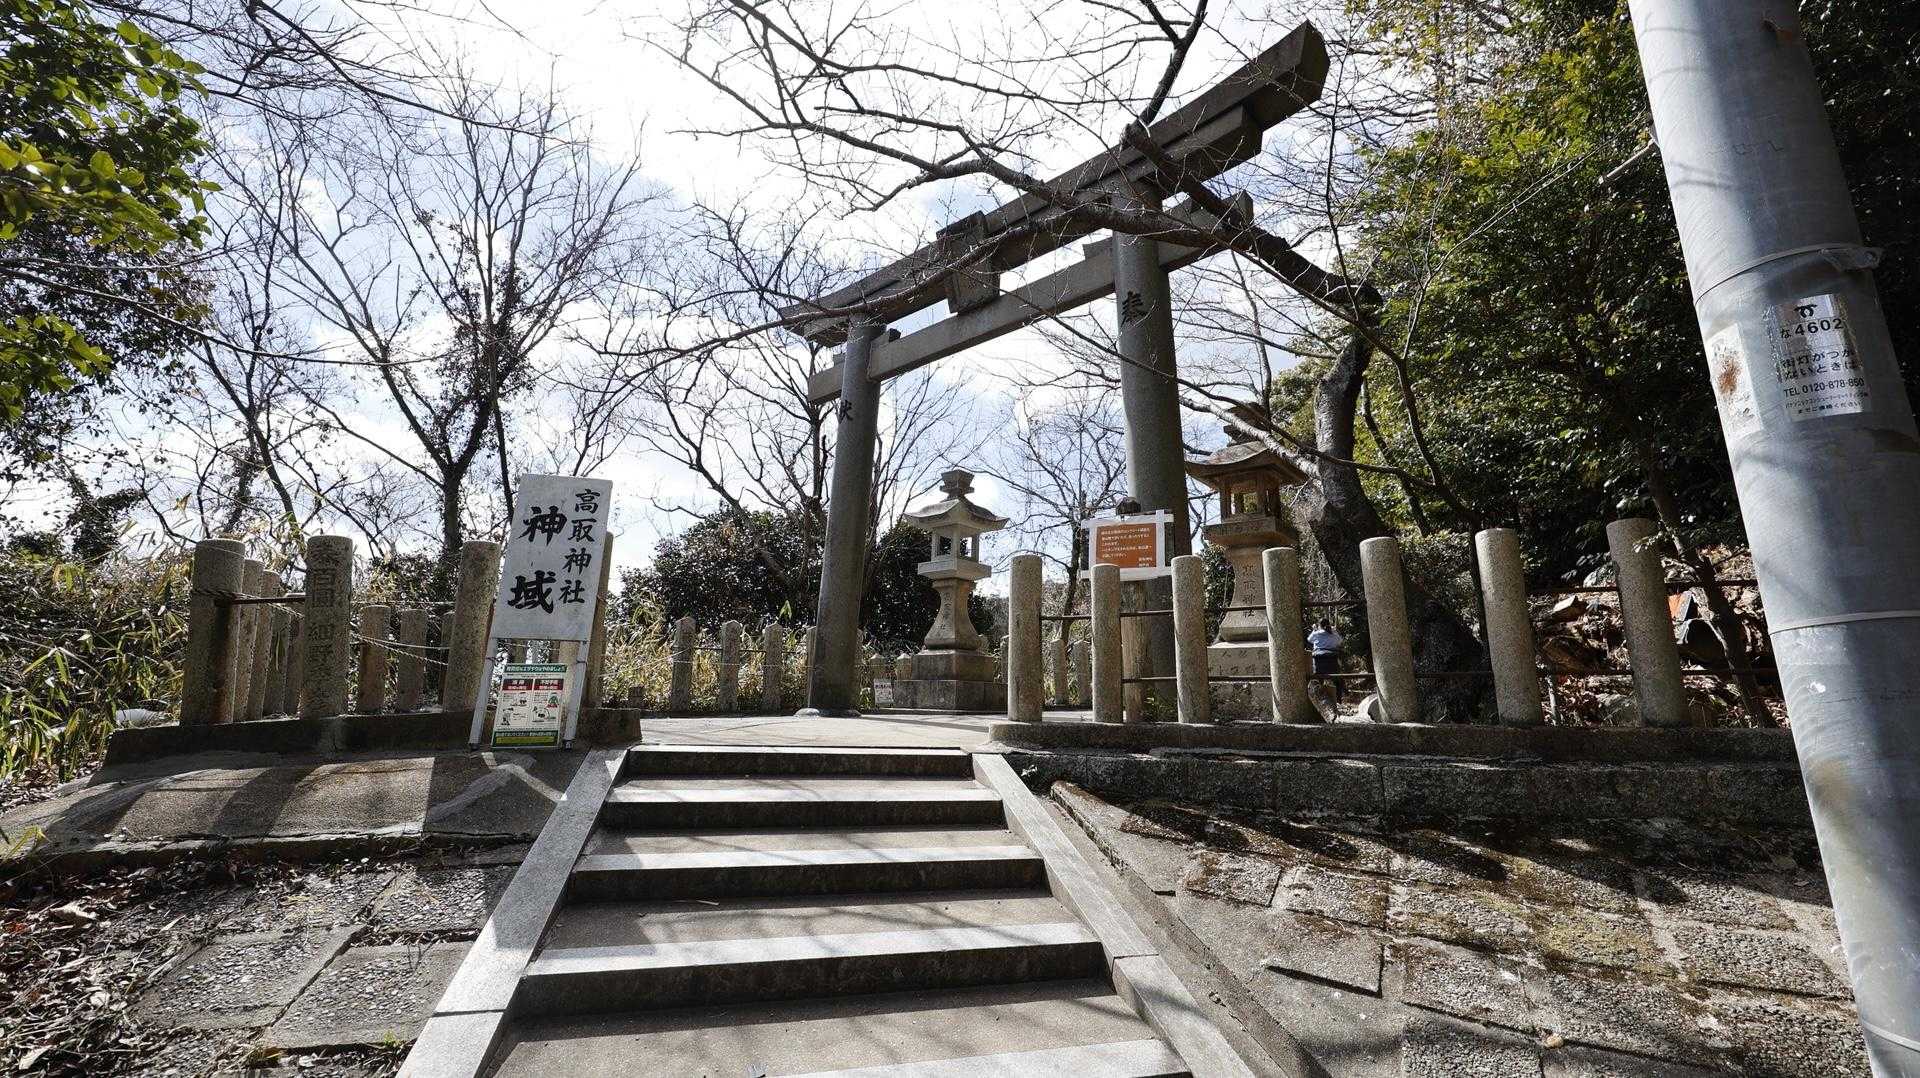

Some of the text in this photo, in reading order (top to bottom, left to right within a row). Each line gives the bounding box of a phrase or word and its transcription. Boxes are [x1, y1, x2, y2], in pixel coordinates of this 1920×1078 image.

[1784, 378, 1865, 398] TEL 0120-878-850
[507, 505, 568, 615] 神域
[559, 488, 601, 604] 高取神社
